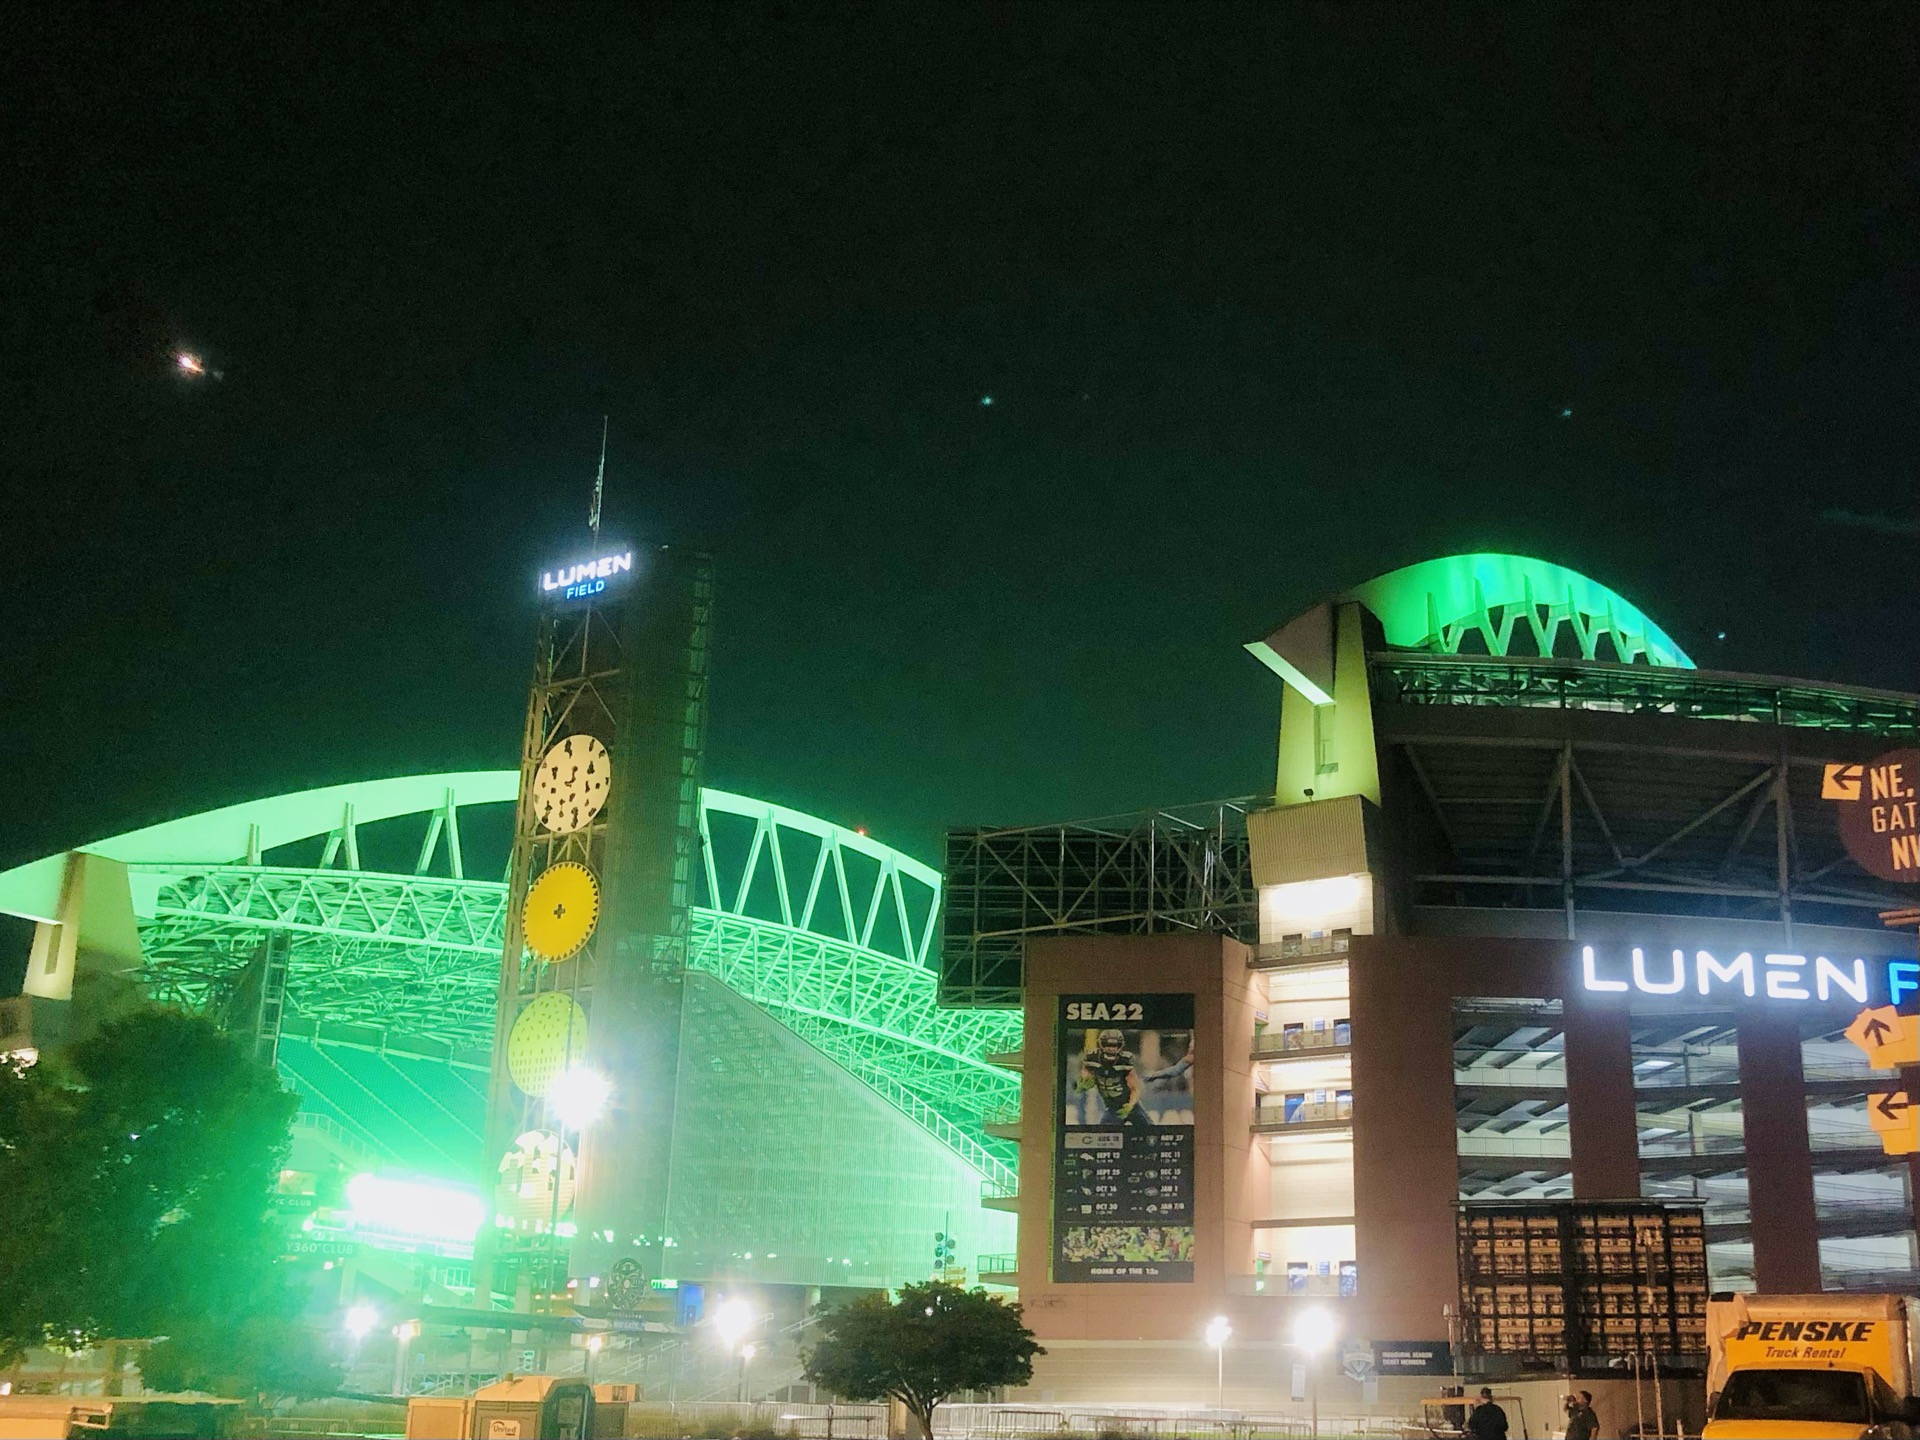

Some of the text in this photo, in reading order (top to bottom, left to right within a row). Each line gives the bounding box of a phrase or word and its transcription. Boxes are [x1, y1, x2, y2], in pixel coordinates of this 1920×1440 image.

[543, 552, 631, 591] LUMEN
[566, 580, 605, 600] FIELD
[1582, 946, 1868, 1004] LUMEN
[1066, 1002, 1143, 1020] SEA22
[1736, 1321, 1875, 1342] PENSKE
[1765, 1346, 1847, 1359] Truck Rental
[493, 1425, 517, 1433] United
